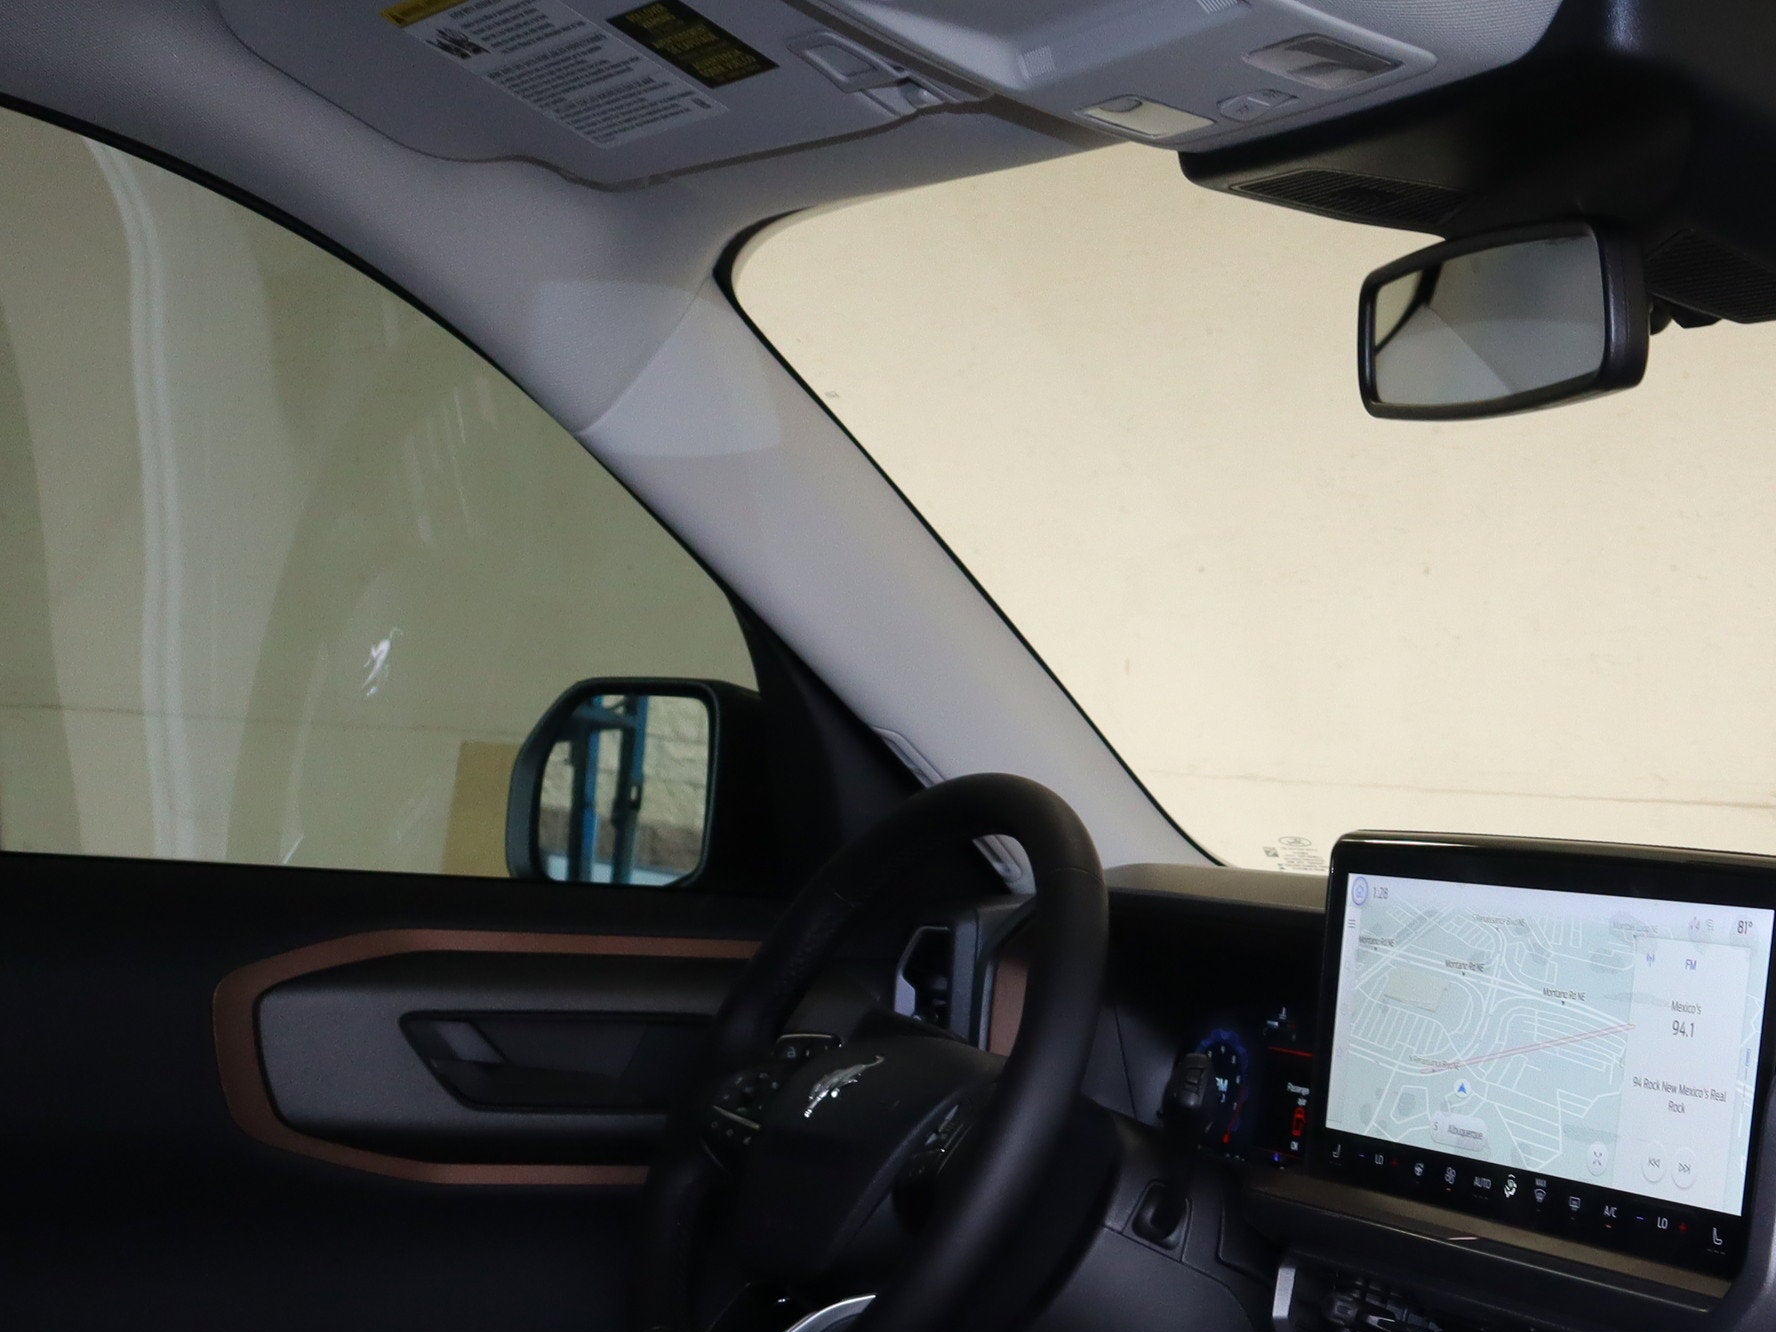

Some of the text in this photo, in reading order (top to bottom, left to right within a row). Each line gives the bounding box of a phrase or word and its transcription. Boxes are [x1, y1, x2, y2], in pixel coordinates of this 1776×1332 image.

[1685, 958, 1697, 970] FM
[1671, 1000, 1702, 1015] Mexico's
[1672, 1020, 1694, 1038] 94.1
[1632, 1076, 1726, 1102] 94 Rock New Mexico's Real
[1668, 1101, 1686, 1114] Rock
[1374, 1154, 1384, 1166] LO
[1474, 1176, 1492, 1190] AUTO
[1604, 1205, 1617, 1218] A/C
[1657, 1216, 1668, 1230] LO
